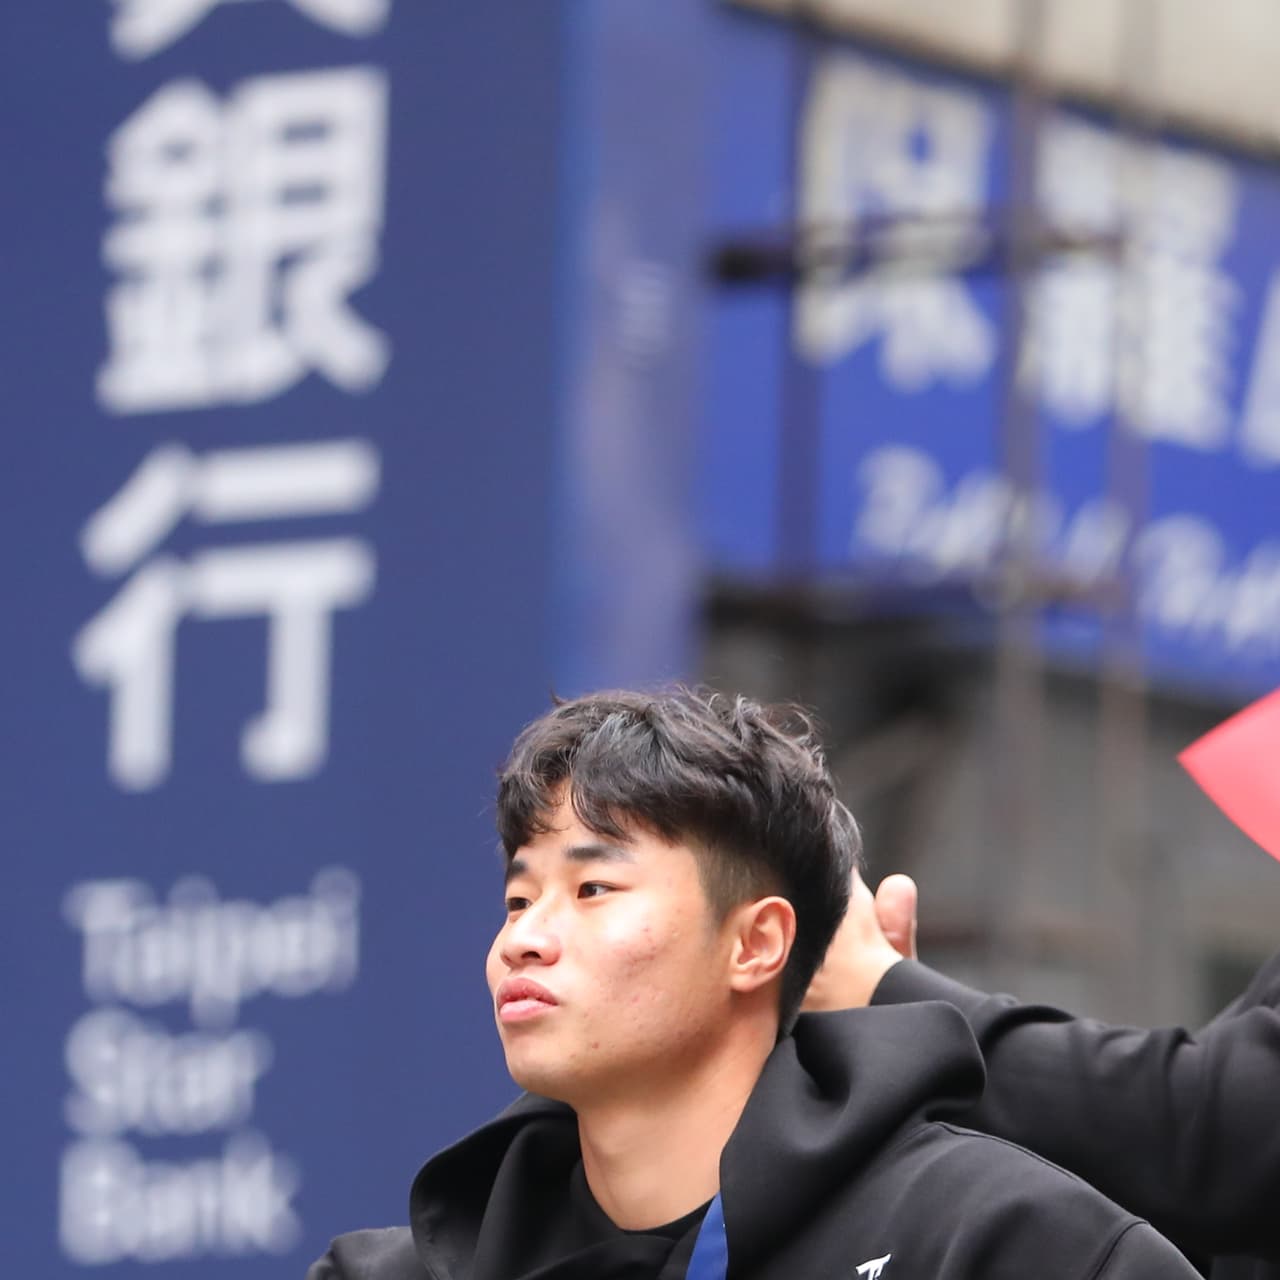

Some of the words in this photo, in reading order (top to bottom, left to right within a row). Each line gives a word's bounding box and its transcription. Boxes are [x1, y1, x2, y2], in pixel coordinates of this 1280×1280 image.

[64, 868, 361, 1030] Taipei
[65, 1008, 273, 1136] Star
[60, 1130, 301, 1263] Bank
